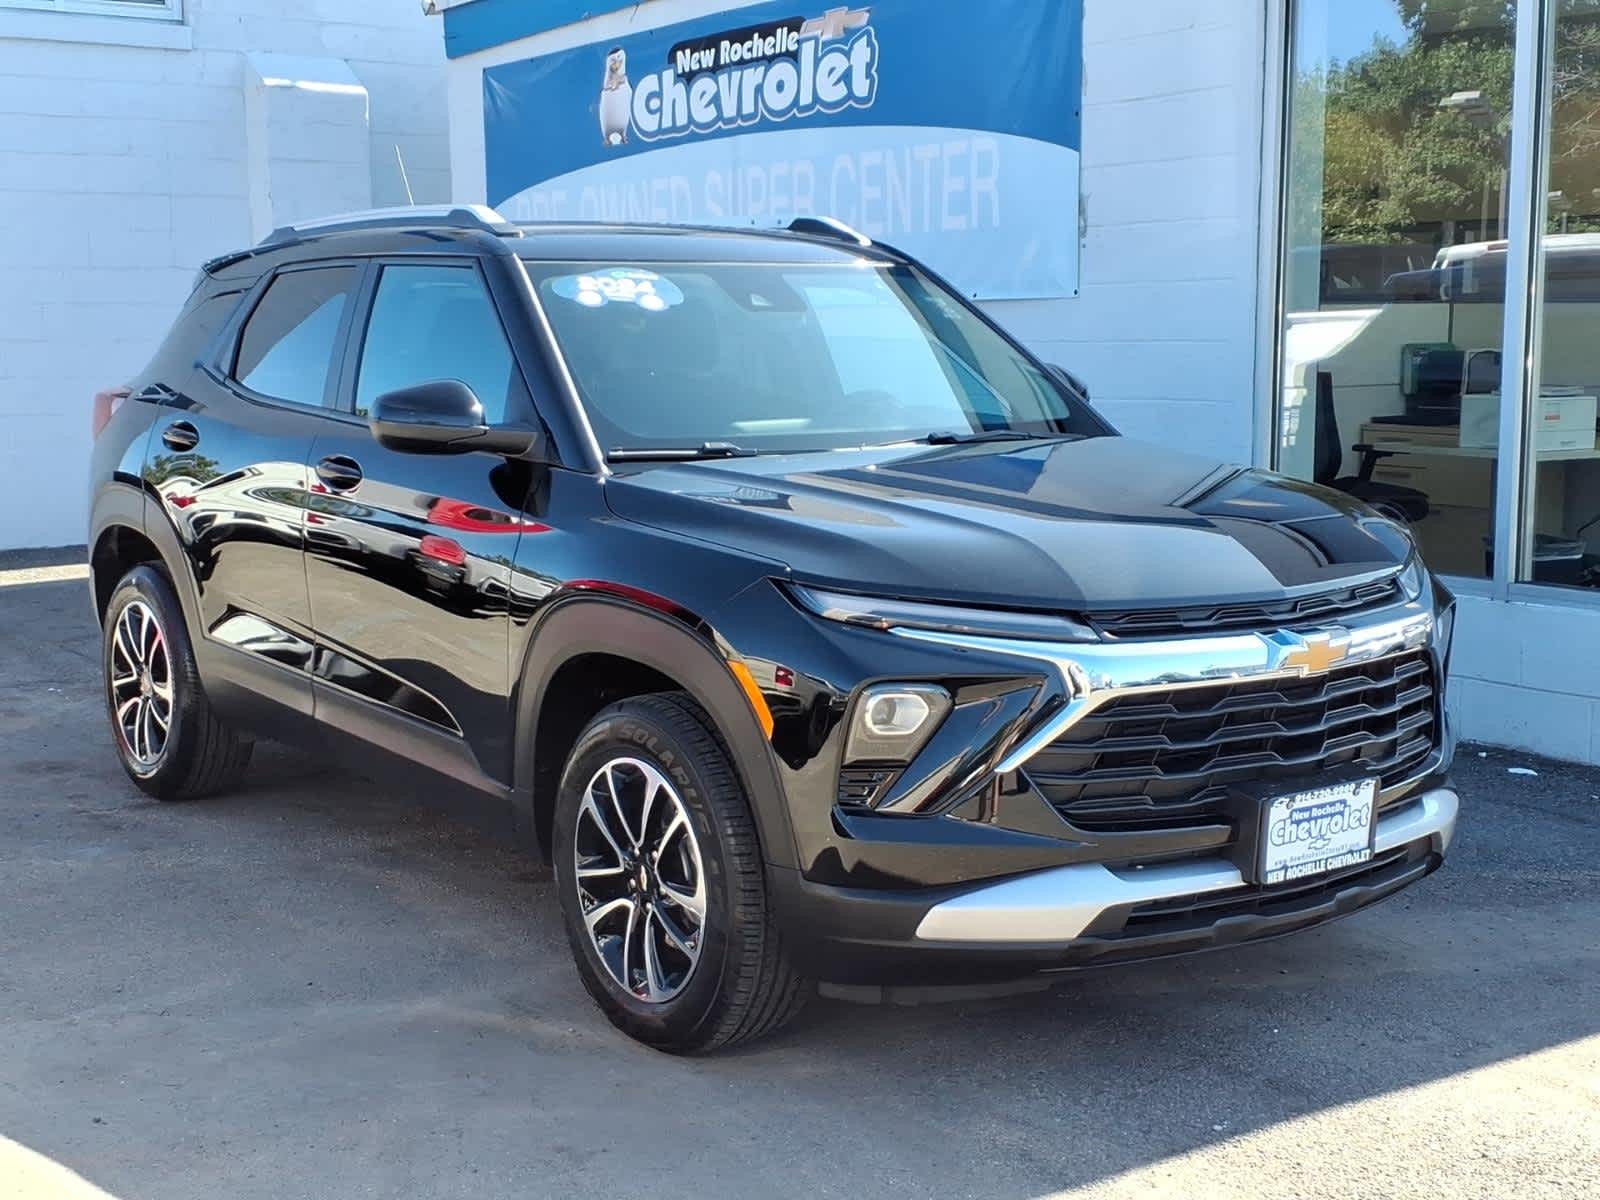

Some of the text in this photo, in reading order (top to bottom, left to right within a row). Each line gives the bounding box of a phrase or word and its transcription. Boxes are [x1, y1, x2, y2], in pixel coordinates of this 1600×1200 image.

[676, 26, 799, 75] New Rochelle
[632, 33, 872, 133] Chevrolet
[704, 159, 816, 221] SUPER
[829, 136, 1000, 237] CENTER
[1270, 802, 1370, 847] Chevrolet
[1291, 803, 1345, 822] New Rochelle
[1266, 849, 1371, 884] NEW ROCHELLE CHEVROLET
